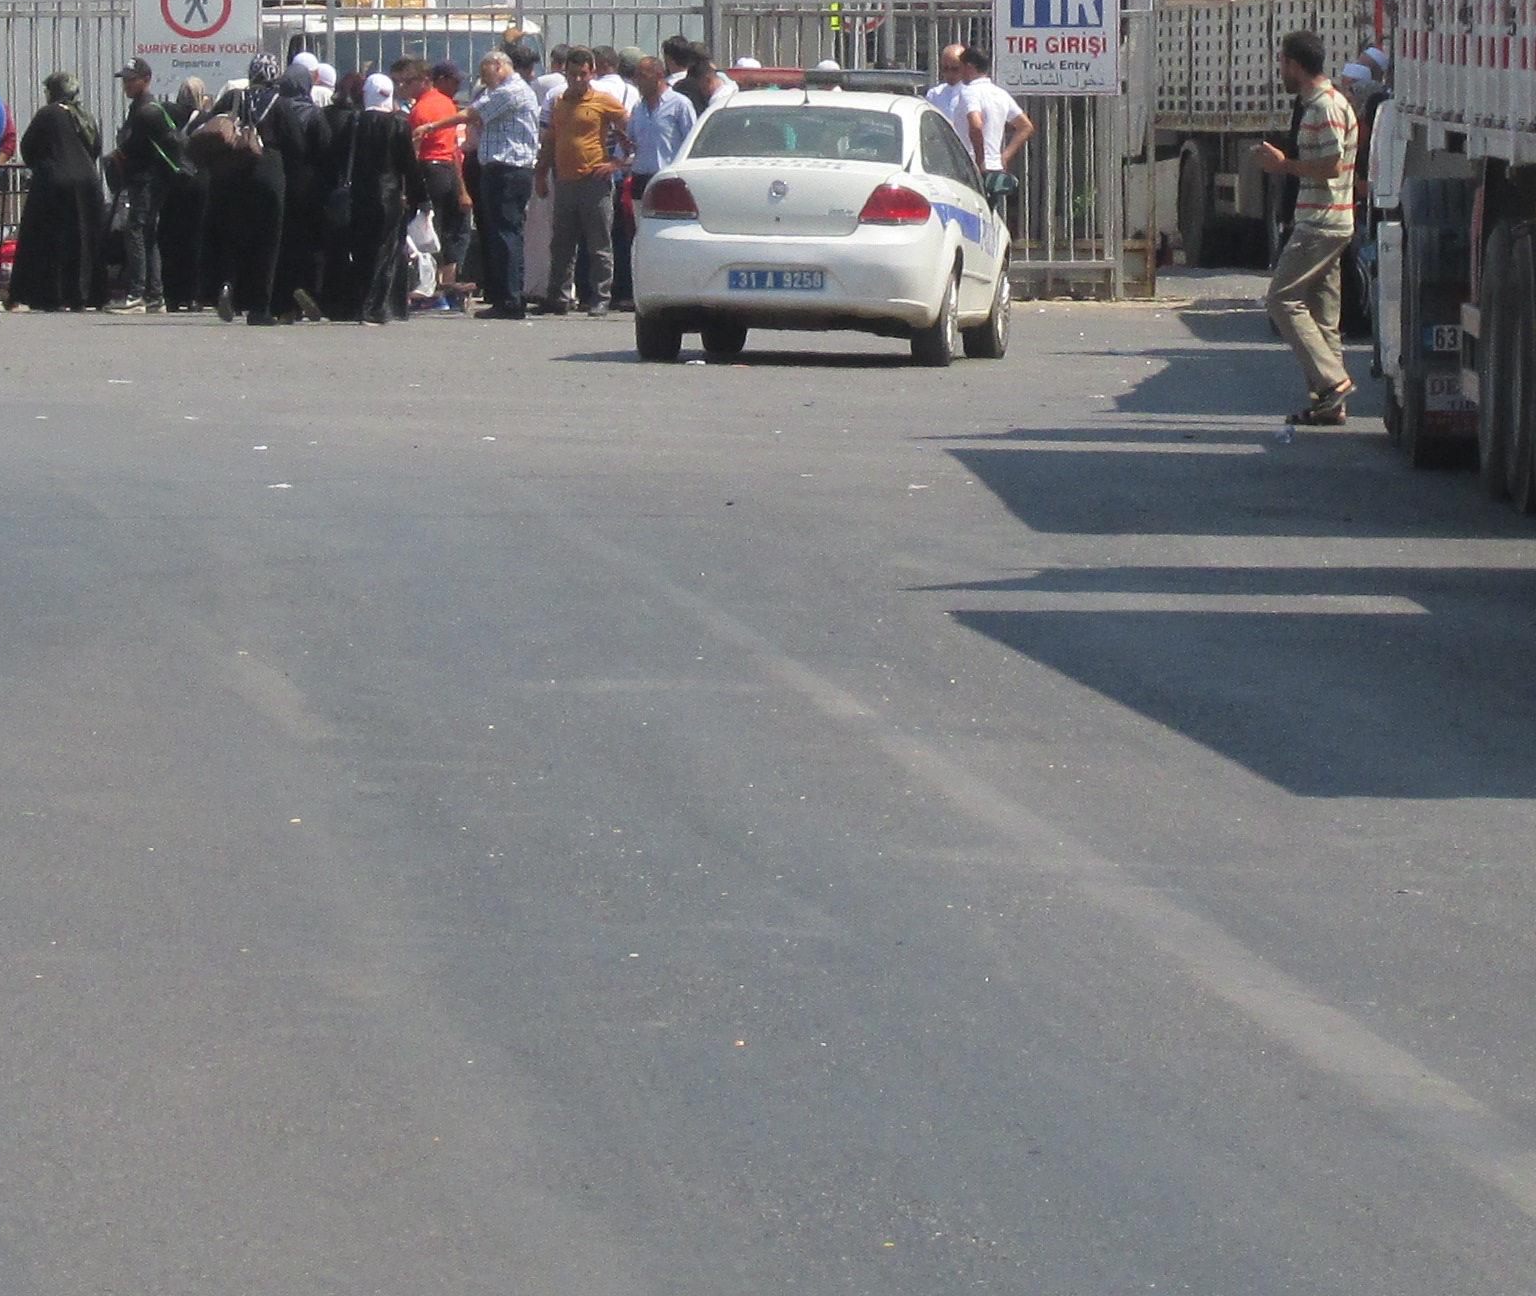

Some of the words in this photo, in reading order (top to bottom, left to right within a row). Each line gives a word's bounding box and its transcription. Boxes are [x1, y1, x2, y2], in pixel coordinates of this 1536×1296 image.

[1005, 36, 1038, 54] TIR
[1045, 31, 1107, 58] GİRİŞİ
[172, 59, 222, 70] Departure
[1022, 59, 1056, 70] Truck
[1060, 59, 1091, 72] Entry
[738, 271, 757, 288] 31
[765, 271, 775, 288] A
[1435, 328, 1458, 349] 63
